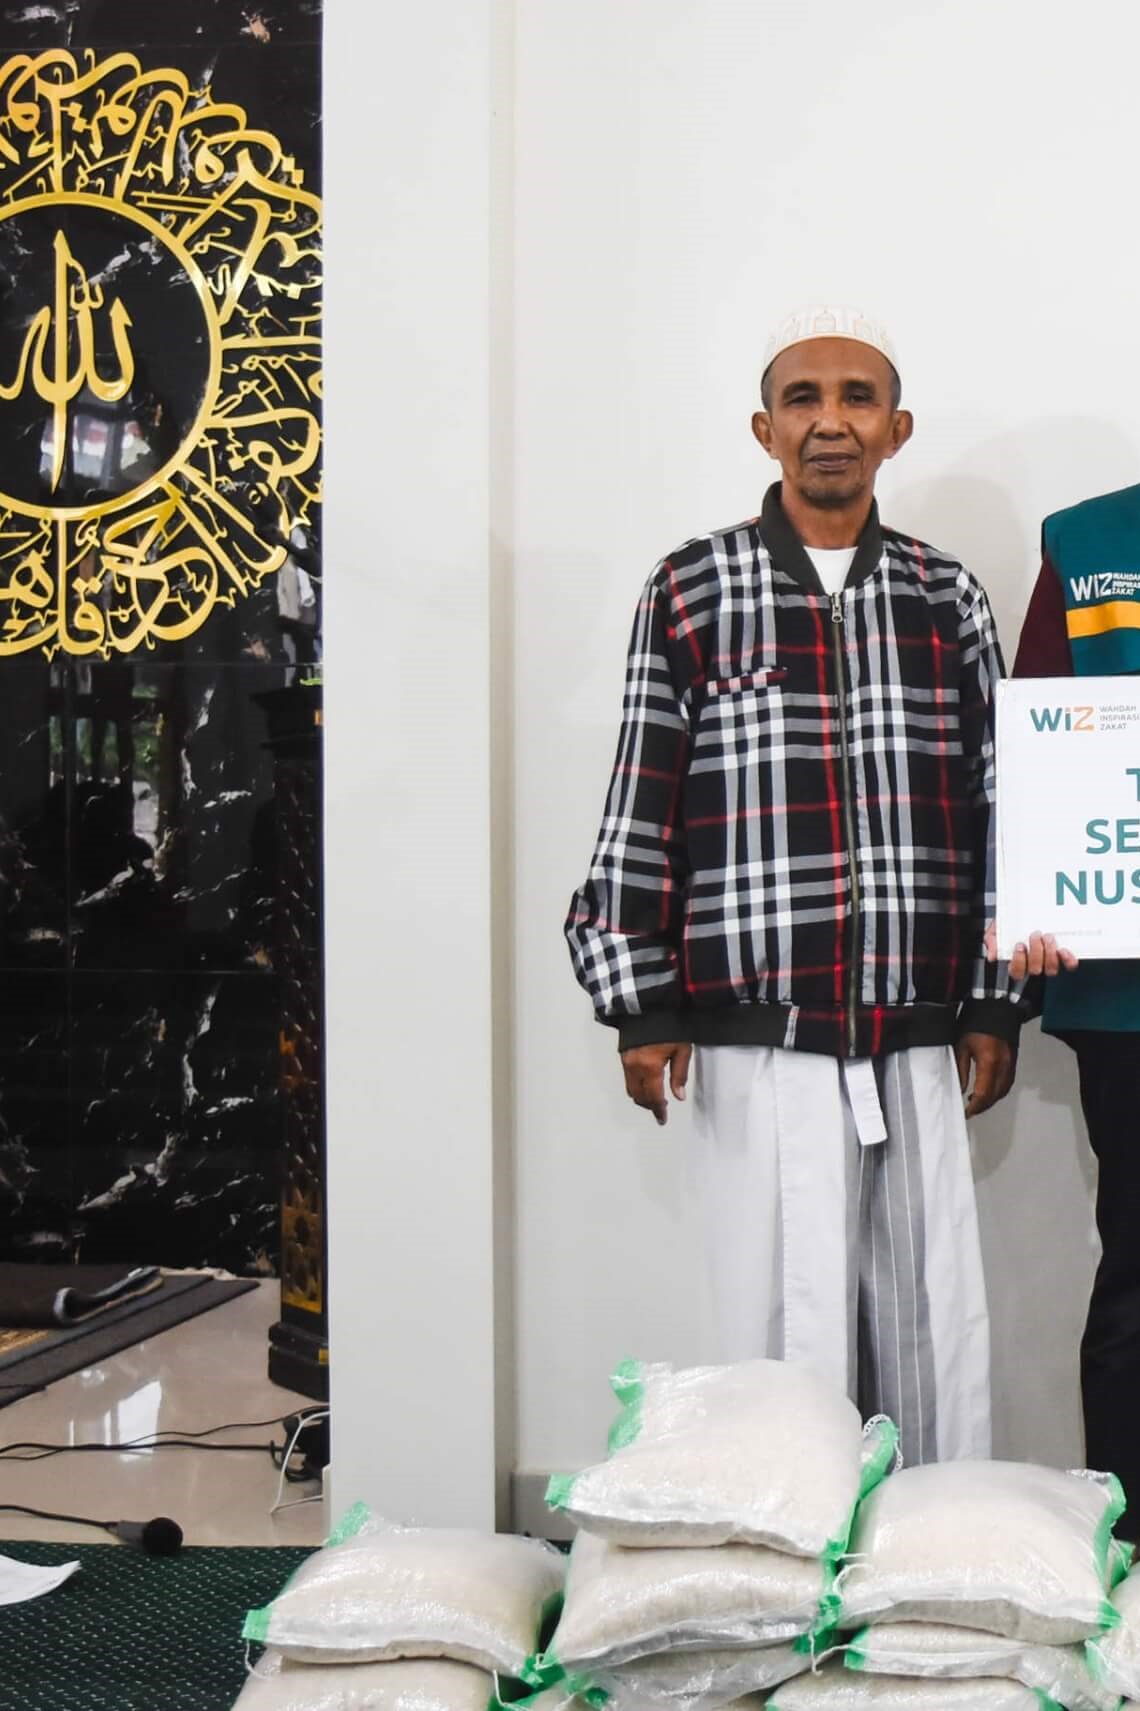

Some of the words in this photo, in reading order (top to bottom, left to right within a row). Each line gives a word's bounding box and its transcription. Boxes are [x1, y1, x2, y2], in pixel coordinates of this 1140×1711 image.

[1099, 704, 1137, 713] WAHDAH
[1030, 706, 1095, 732] WiZ
[1099, 713, 1140, 722] INSPIRASI
[1100, 722, 1127, 731] ZAKAT
